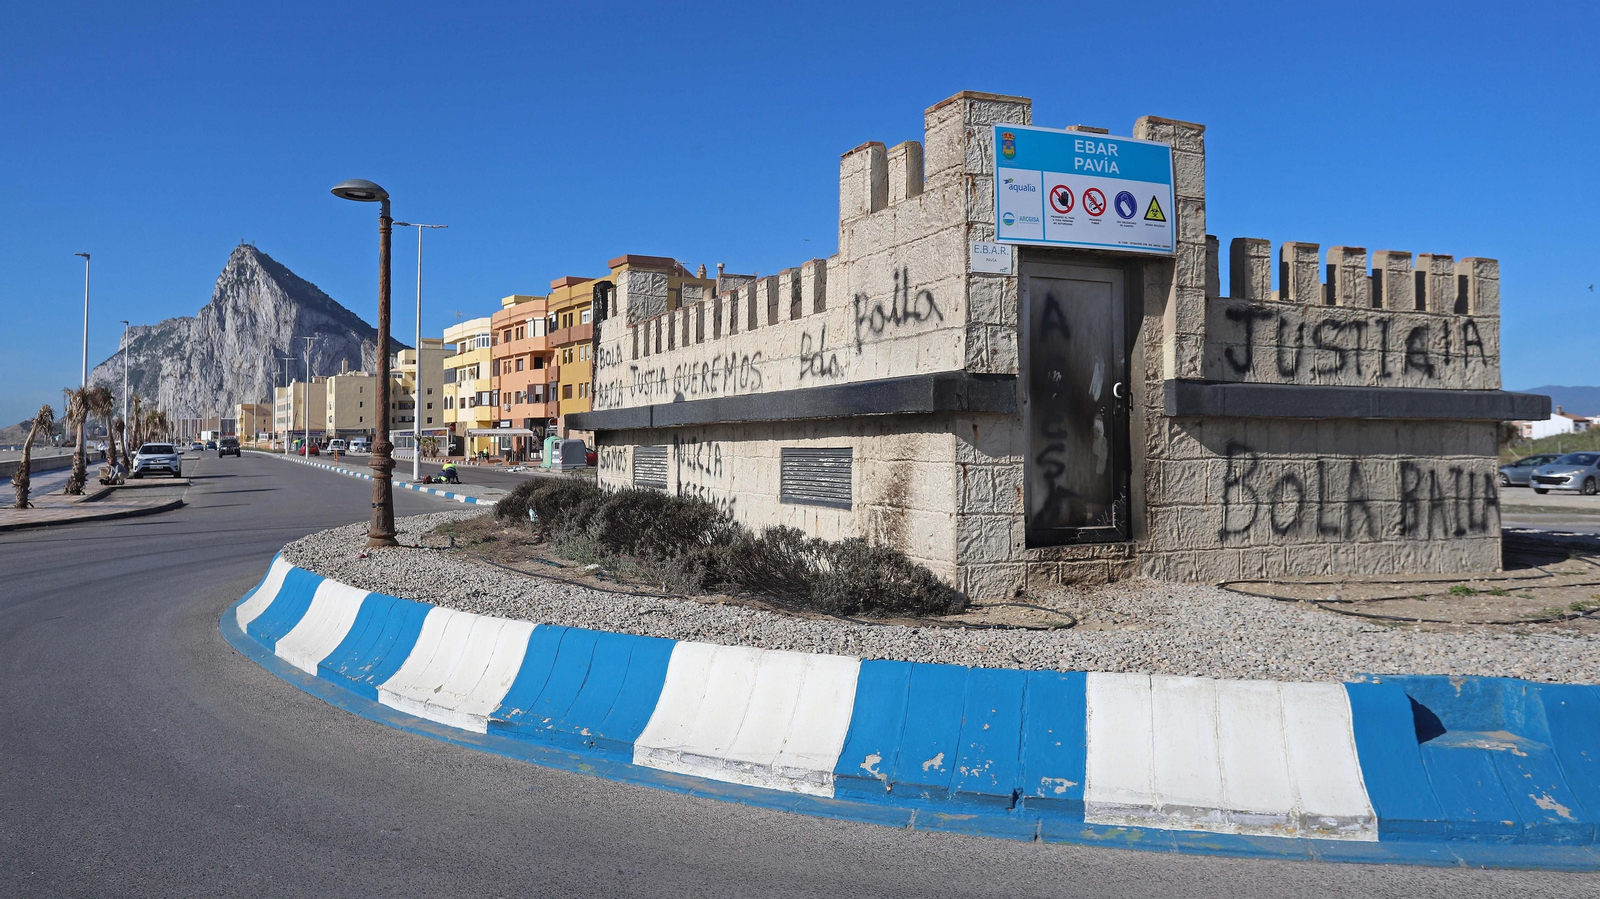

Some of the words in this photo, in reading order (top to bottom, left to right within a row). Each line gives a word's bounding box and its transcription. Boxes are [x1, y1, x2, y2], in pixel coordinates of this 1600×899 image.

[1074, 139, 1119, 157] EBAR
[1074, 156, 1120, 175] PAVÍA
[1008, 183, 1036, 193] aqualia
[974, 244, 1009, 256] E.B.A.R.
[673, 351, 762, 395] QUEREMOS
[600, 445, 627, 472] SOMOS
[1218, 438, 1376, 541] BOLA
